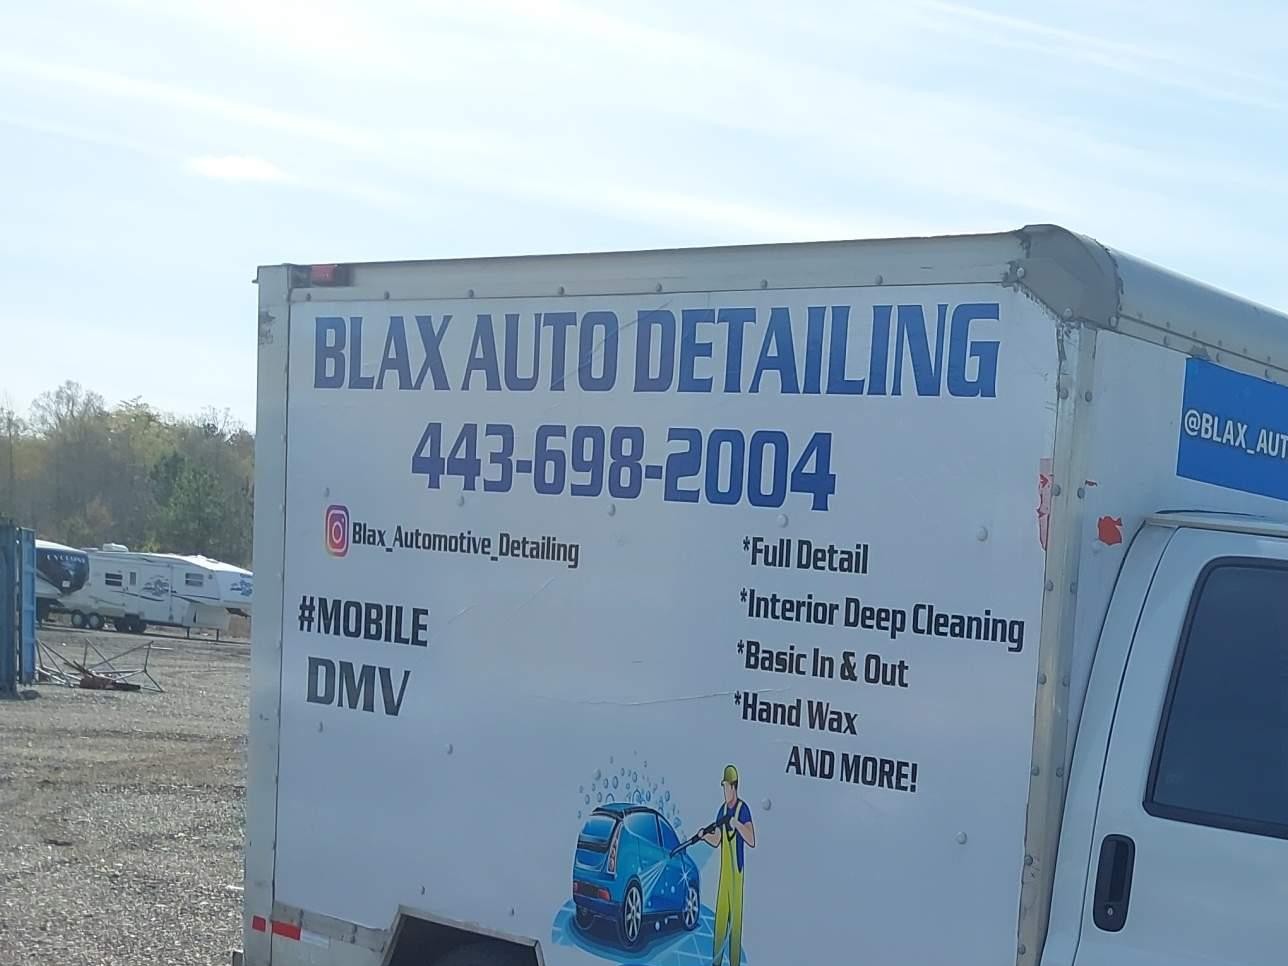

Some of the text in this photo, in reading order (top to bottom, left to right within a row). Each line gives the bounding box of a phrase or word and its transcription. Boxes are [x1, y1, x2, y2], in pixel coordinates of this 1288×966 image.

[314, 303, 1001, 398] BLAX AUTO DETAILING
[411, 422, 836, 511] 443-698-2004
[352, 521, 580, 569] Blax_Automotive_Detailing
[797, 539, 869, 574] Detail
[298, 595, 429, 647] #MOBILE
[844, 597, 906, 639] Deep
[912, 603, 1025, 652] Cleaning
[306, 656, 411, 717] DMV
[812, 648, 834, 678] In
[840, 651, 858, 682] &
[864, 654, 909, 687] Out
[807, 700, 859, 735] Wax
[785, 746, 918, 793] AND MORE!
